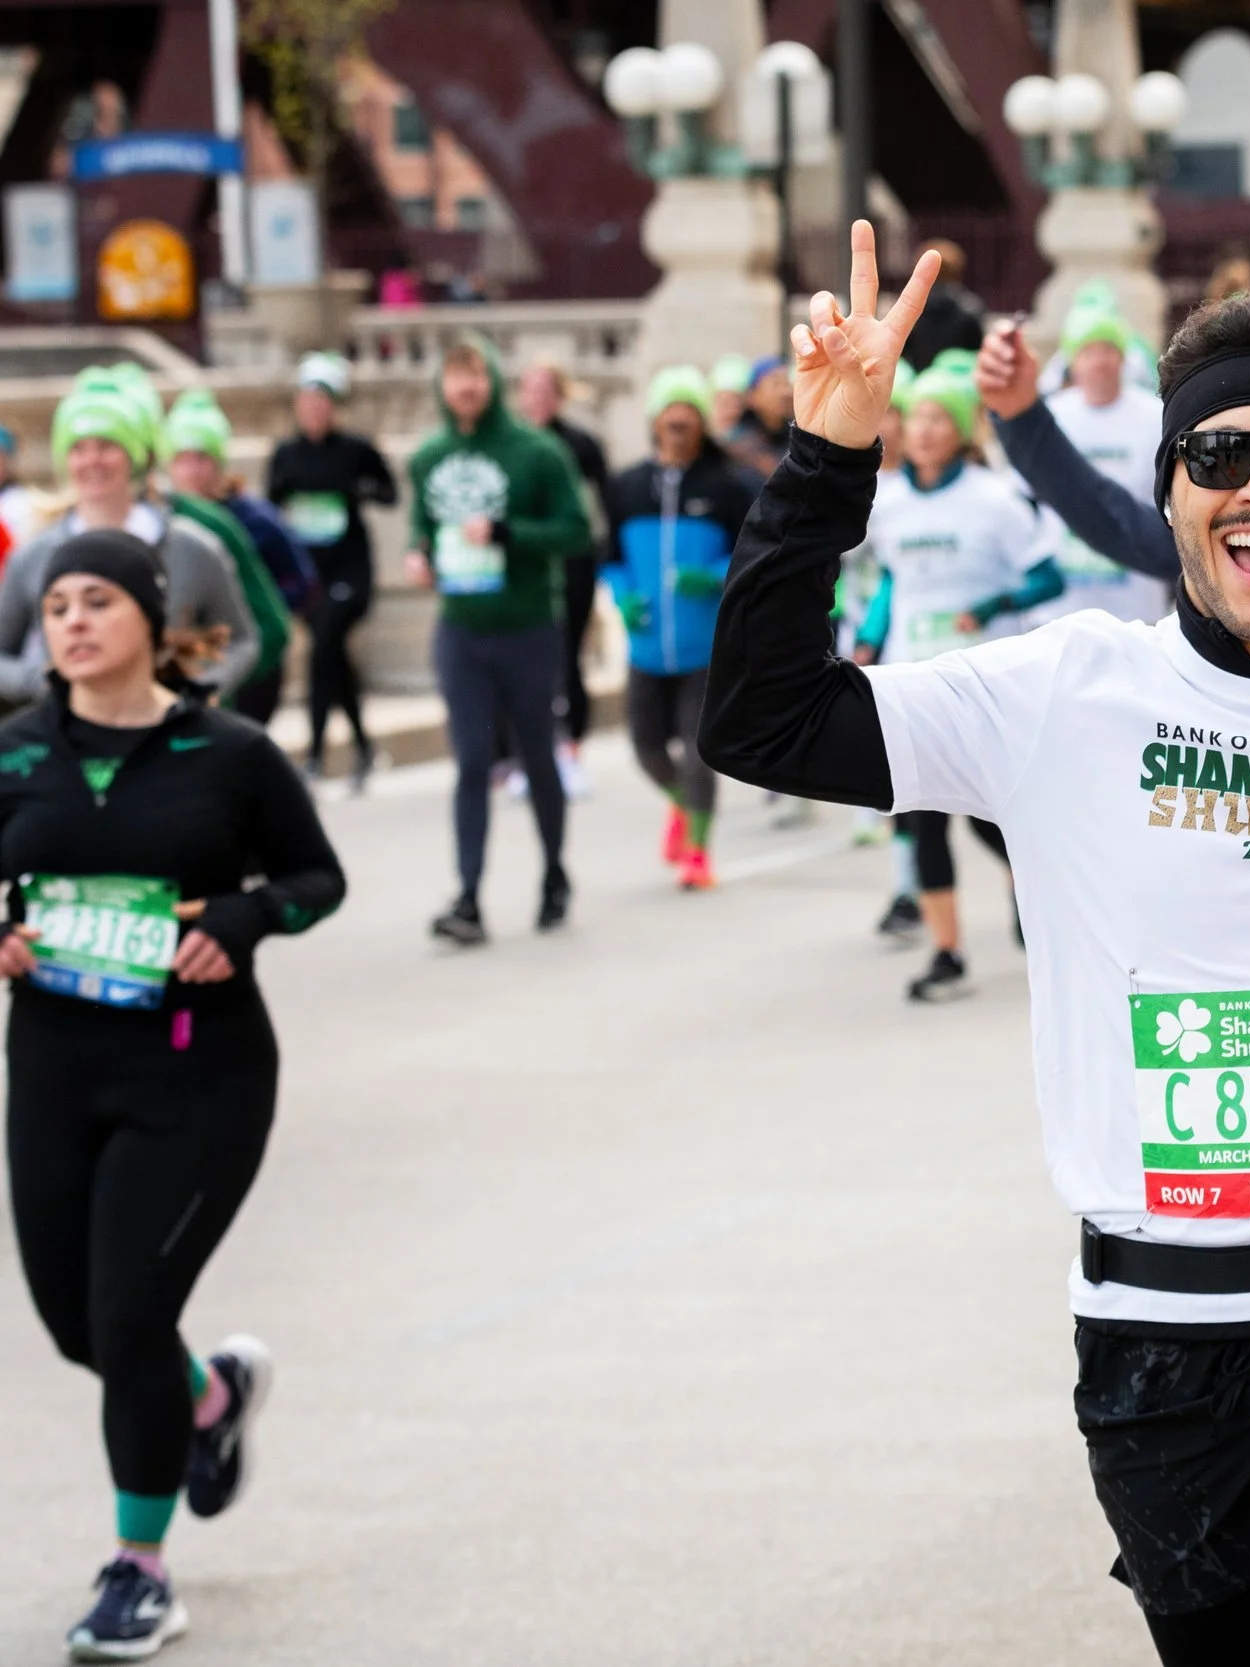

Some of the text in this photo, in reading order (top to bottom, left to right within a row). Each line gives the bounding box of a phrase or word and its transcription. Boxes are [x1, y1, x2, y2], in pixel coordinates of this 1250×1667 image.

[1156, 722, 1222, 747] BANK
[1165, 1072, 1195, 1142] C
[1160, 1187, 1222, 1206] ROW 7
